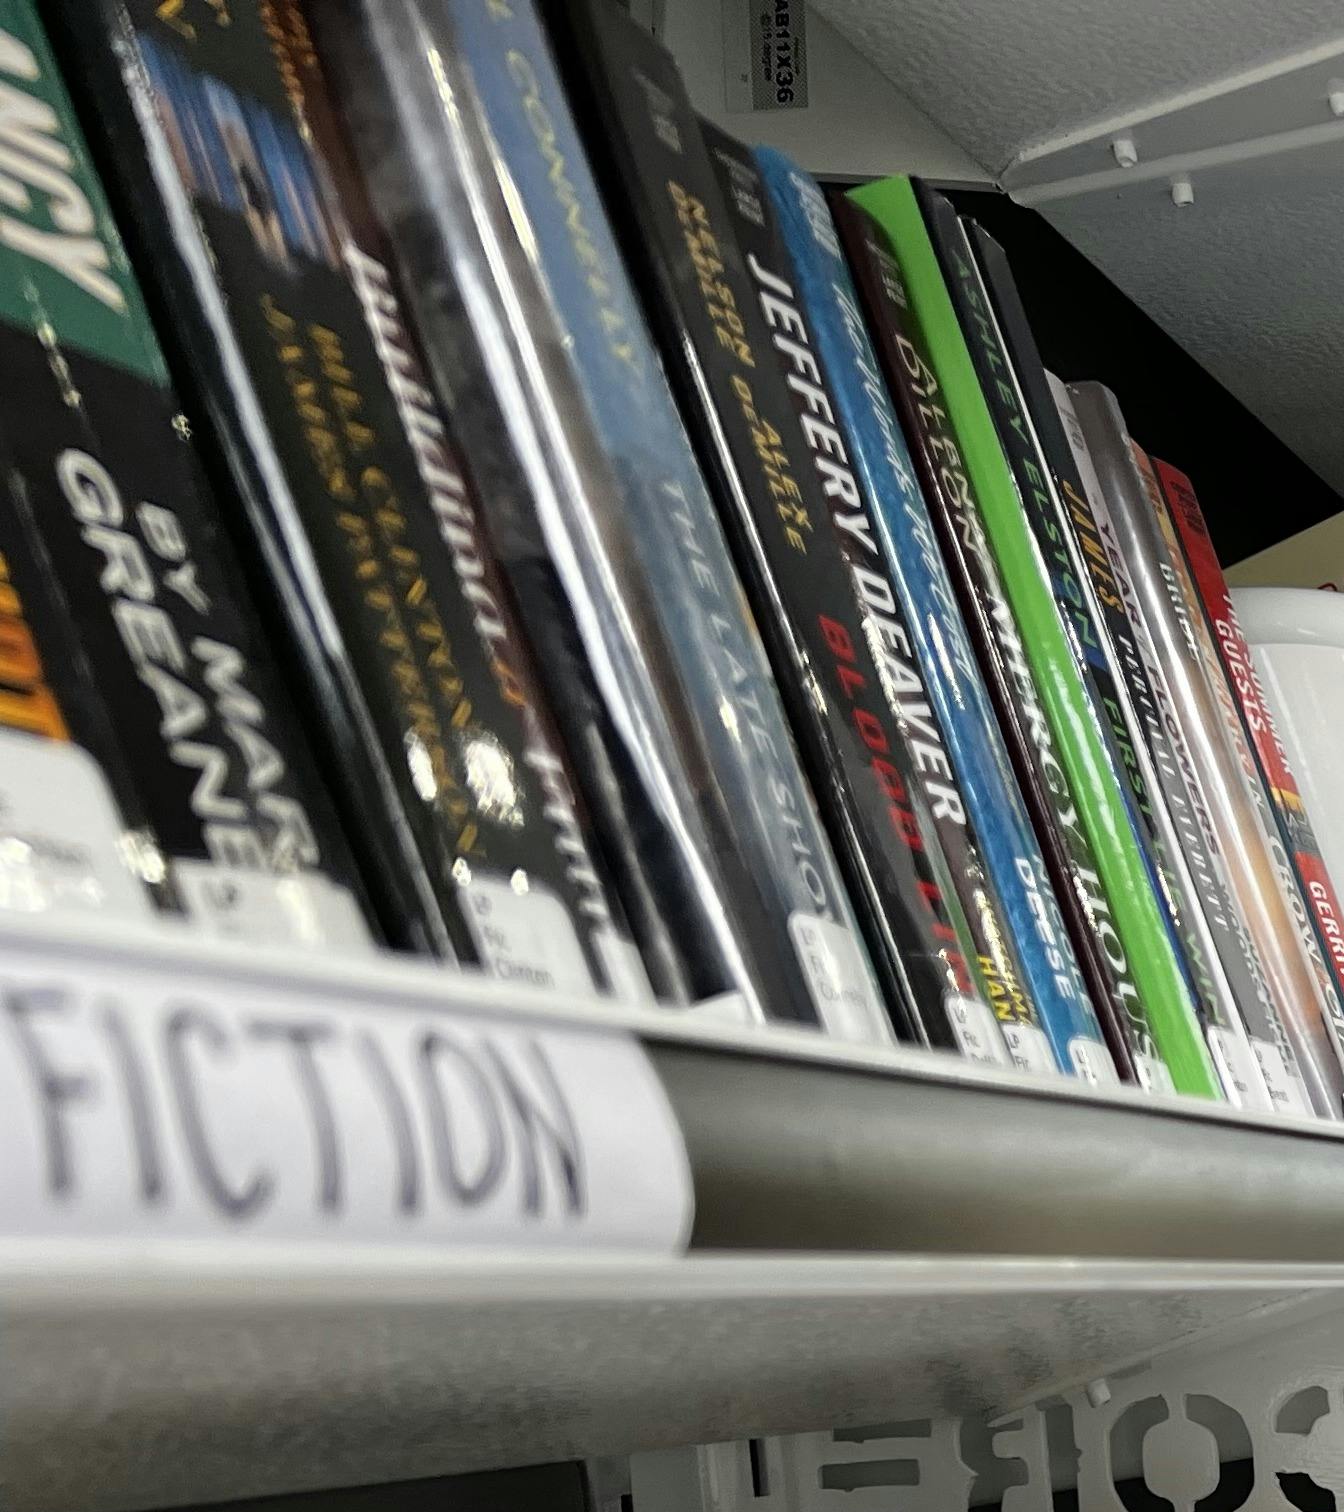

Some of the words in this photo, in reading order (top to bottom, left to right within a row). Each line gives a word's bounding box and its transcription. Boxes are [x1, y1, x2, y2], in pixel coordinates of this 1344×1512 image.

[685, 193, 756, 368] NELSON
[748, 253, 880, 556] JEFFERY
[849, 563, 968, 829] DEAVER
[763, 416, 814, 533] ALEX
[894, 331, 978, 553] DILLON
[951, 247, 1029, 446] ASHLEY
[1022, 455, 1098, 648] ELSTON
[134, 500, 213, 613] BY
[662, 480, 723, 595] THE
[711, 611, 782, 766] LATE
[1061, 479, 1123, 613] JAMES
[1099, 520, 1145, 629] YEAR
[818, 614, 926, 847] BLOOD
[1214, 617, 1267, 734] GUESTS
[3, 985, 590, 1222] FICTION
